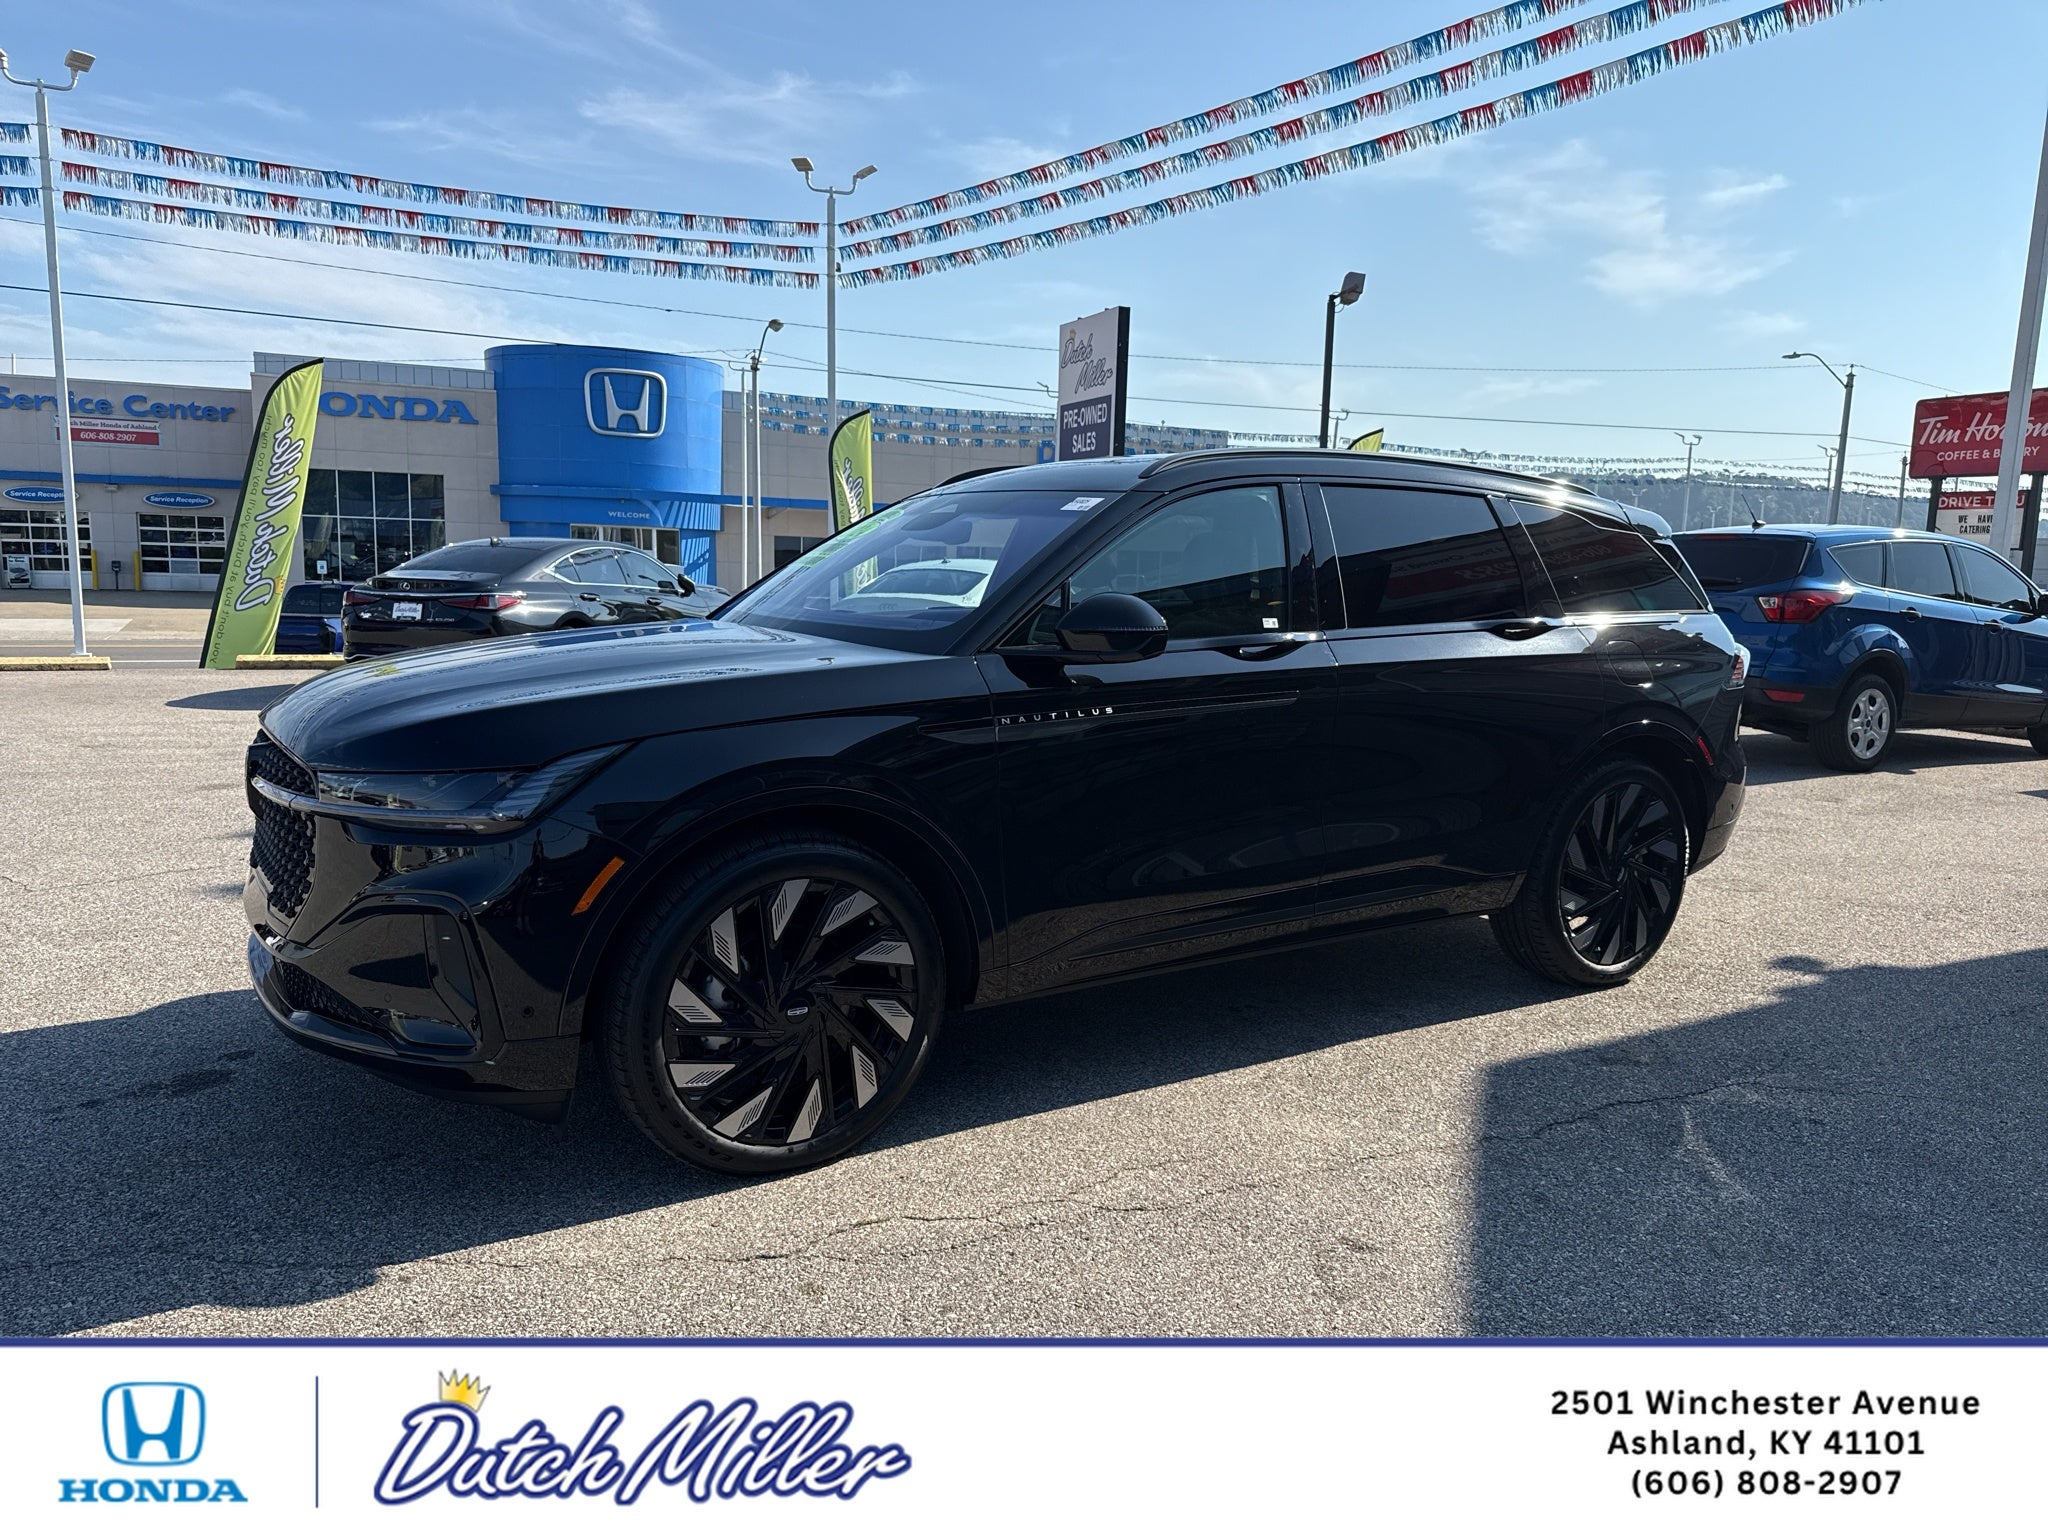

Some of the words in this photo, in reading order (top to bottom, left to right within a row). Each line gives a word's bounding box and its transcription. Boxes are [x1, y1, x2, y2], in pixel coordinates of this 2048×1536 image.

[1060, 332, 1094, 369] Dutch
[1074, 357, 1113, 394] Miller
[123, 394, 236, 422] Center
[319, 391, 479, 425] ONDA
[1063, 403, 1108, 430] PRE-OWNED
[130, 423, 157, 431] Ashland
[1919, 415, 1959, 446] Tim
[80, 431, 137, 442] 606-808-2907
[1071, 431, 1097, 454] SALES
[1937, 449, 1980, 462] COFFEE
[1982, 449, 1990, 459] &
[1993, 446, 2040, 459] BRY
[37, 491, 66, 499] Recepti
[175, 496, 209, 504] Reception
[1938, 496, 1981, 508] DRIVE
[1985, 495, 2025, 507] TU
[608, 511, 651, 519] WELCOME
[1958, 515, 1968, 524] WE
[1959, 525, 1991, 534] CATERING
[1001, 706, 1113, 725] NAUTILUS
